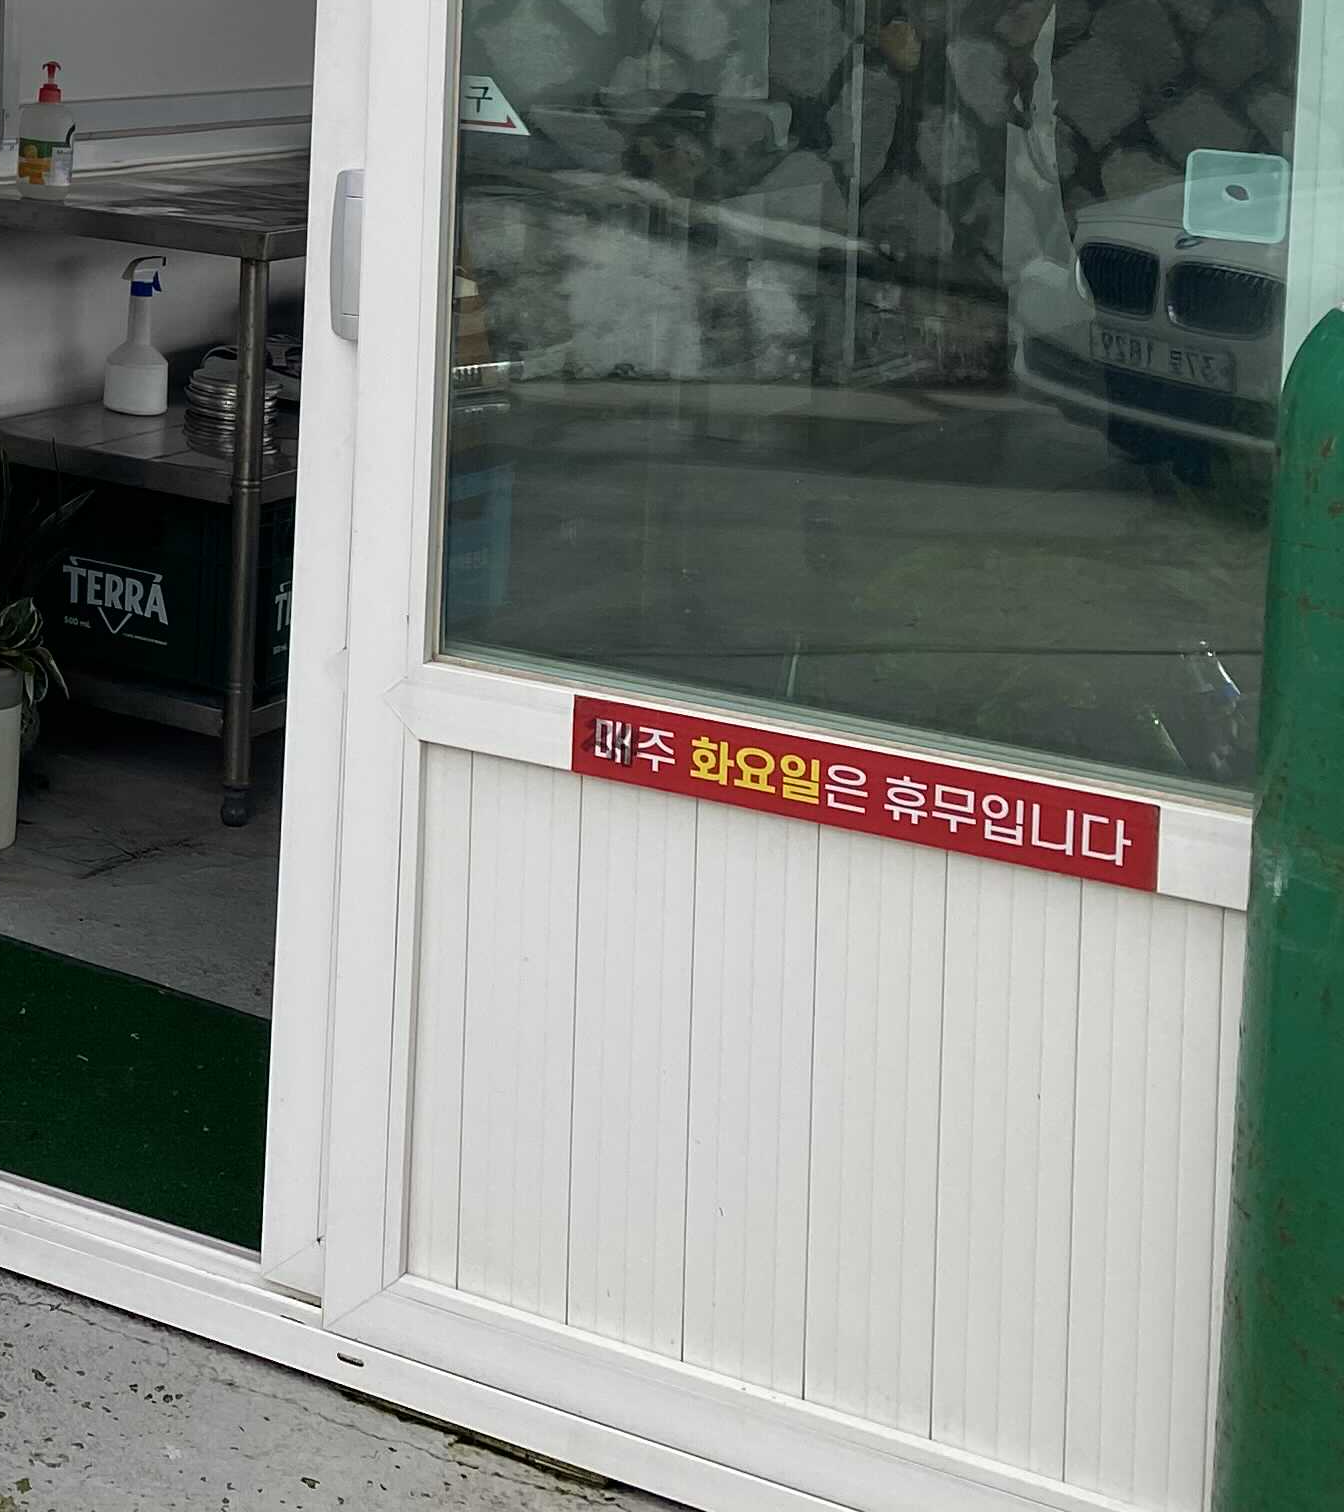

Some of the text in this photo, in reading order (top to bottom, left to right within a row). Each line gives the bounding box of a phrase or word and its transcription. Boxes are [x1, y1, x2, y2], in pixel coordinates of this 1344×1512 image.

[63, 564, 169, 626] TERRA
[593, 717, 1132, 867] 매주 화요일은 휴무입니다
